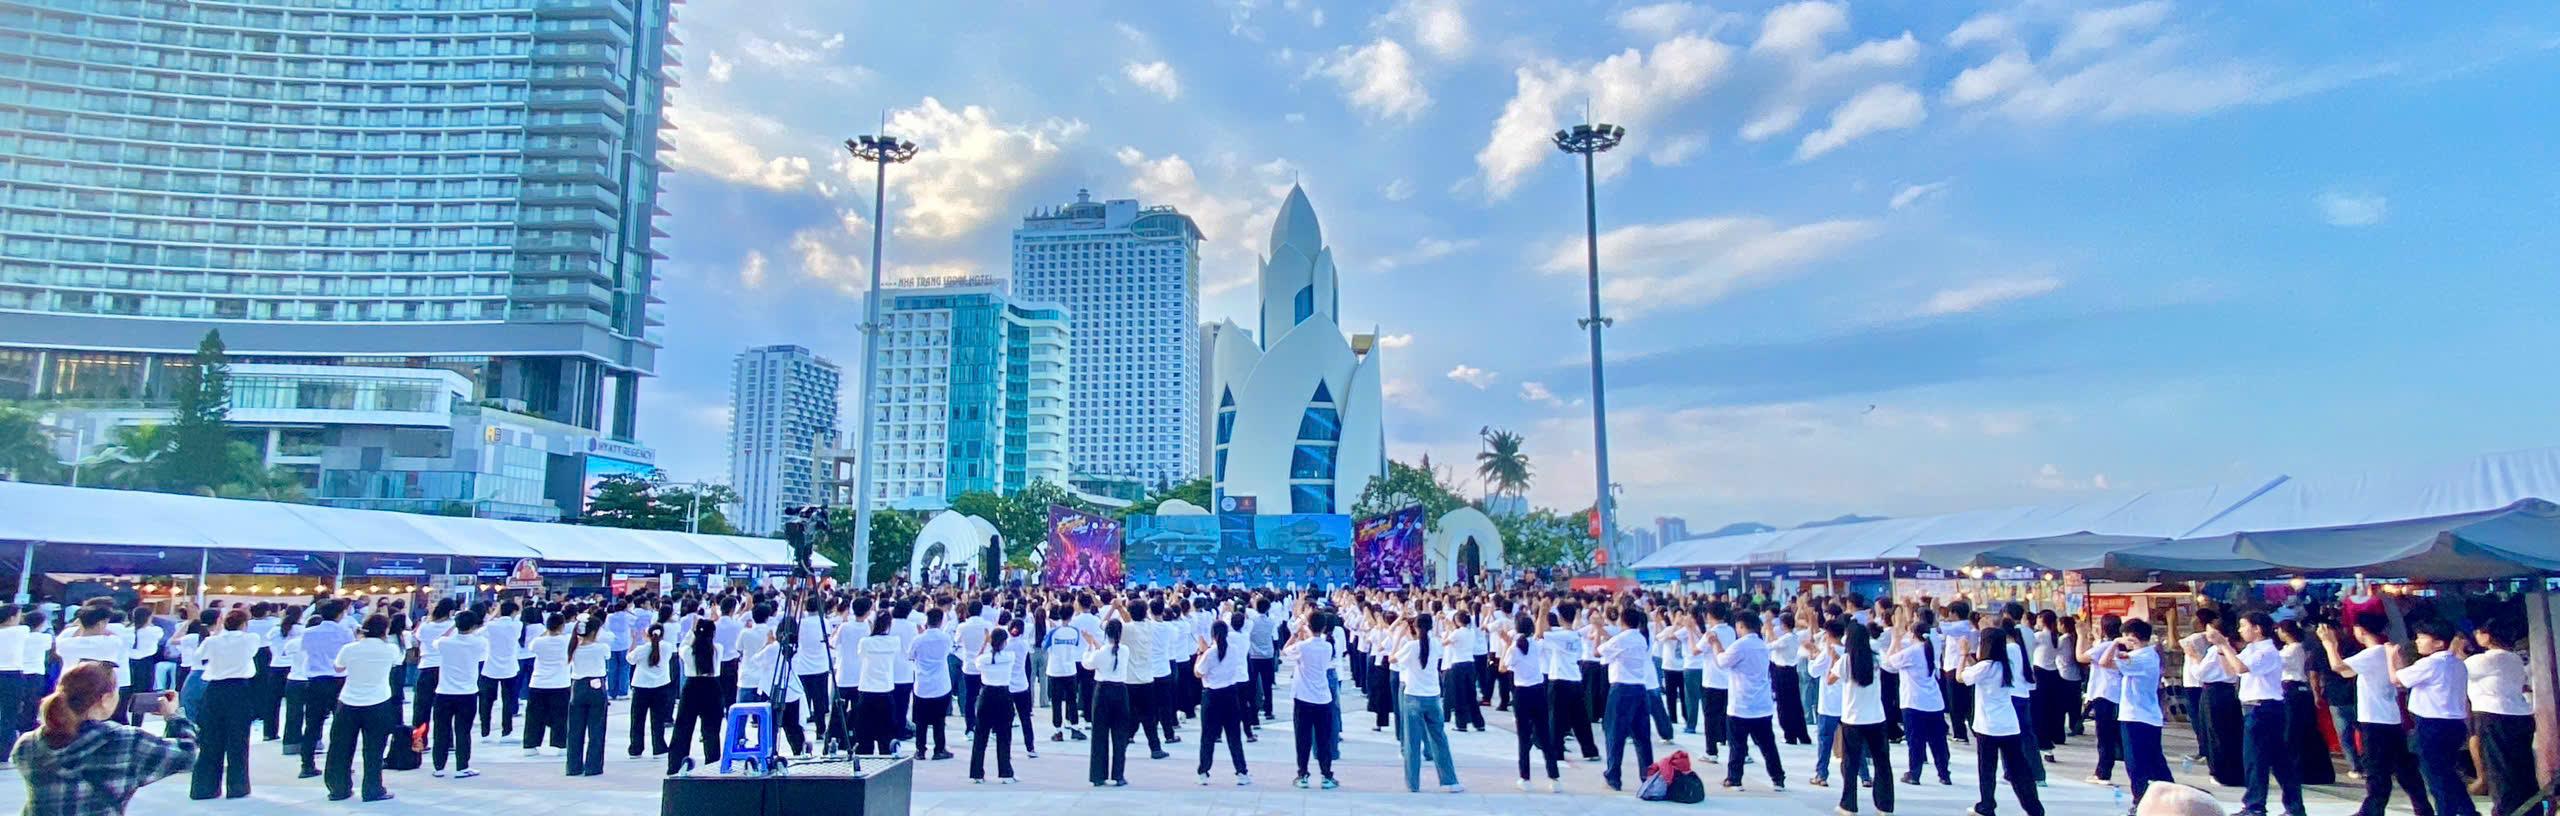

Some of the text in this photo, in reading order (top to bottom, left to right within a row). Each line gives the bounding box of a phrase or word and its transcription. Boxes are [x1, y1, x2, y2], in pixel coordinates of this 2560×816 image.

[898, 276, 915, 287] NHA
[916, 276, 941, 287] TRANG
[968, 273, 992, 285] HOTEL
[599, 441, 652, 460] HYATT REGENCY
